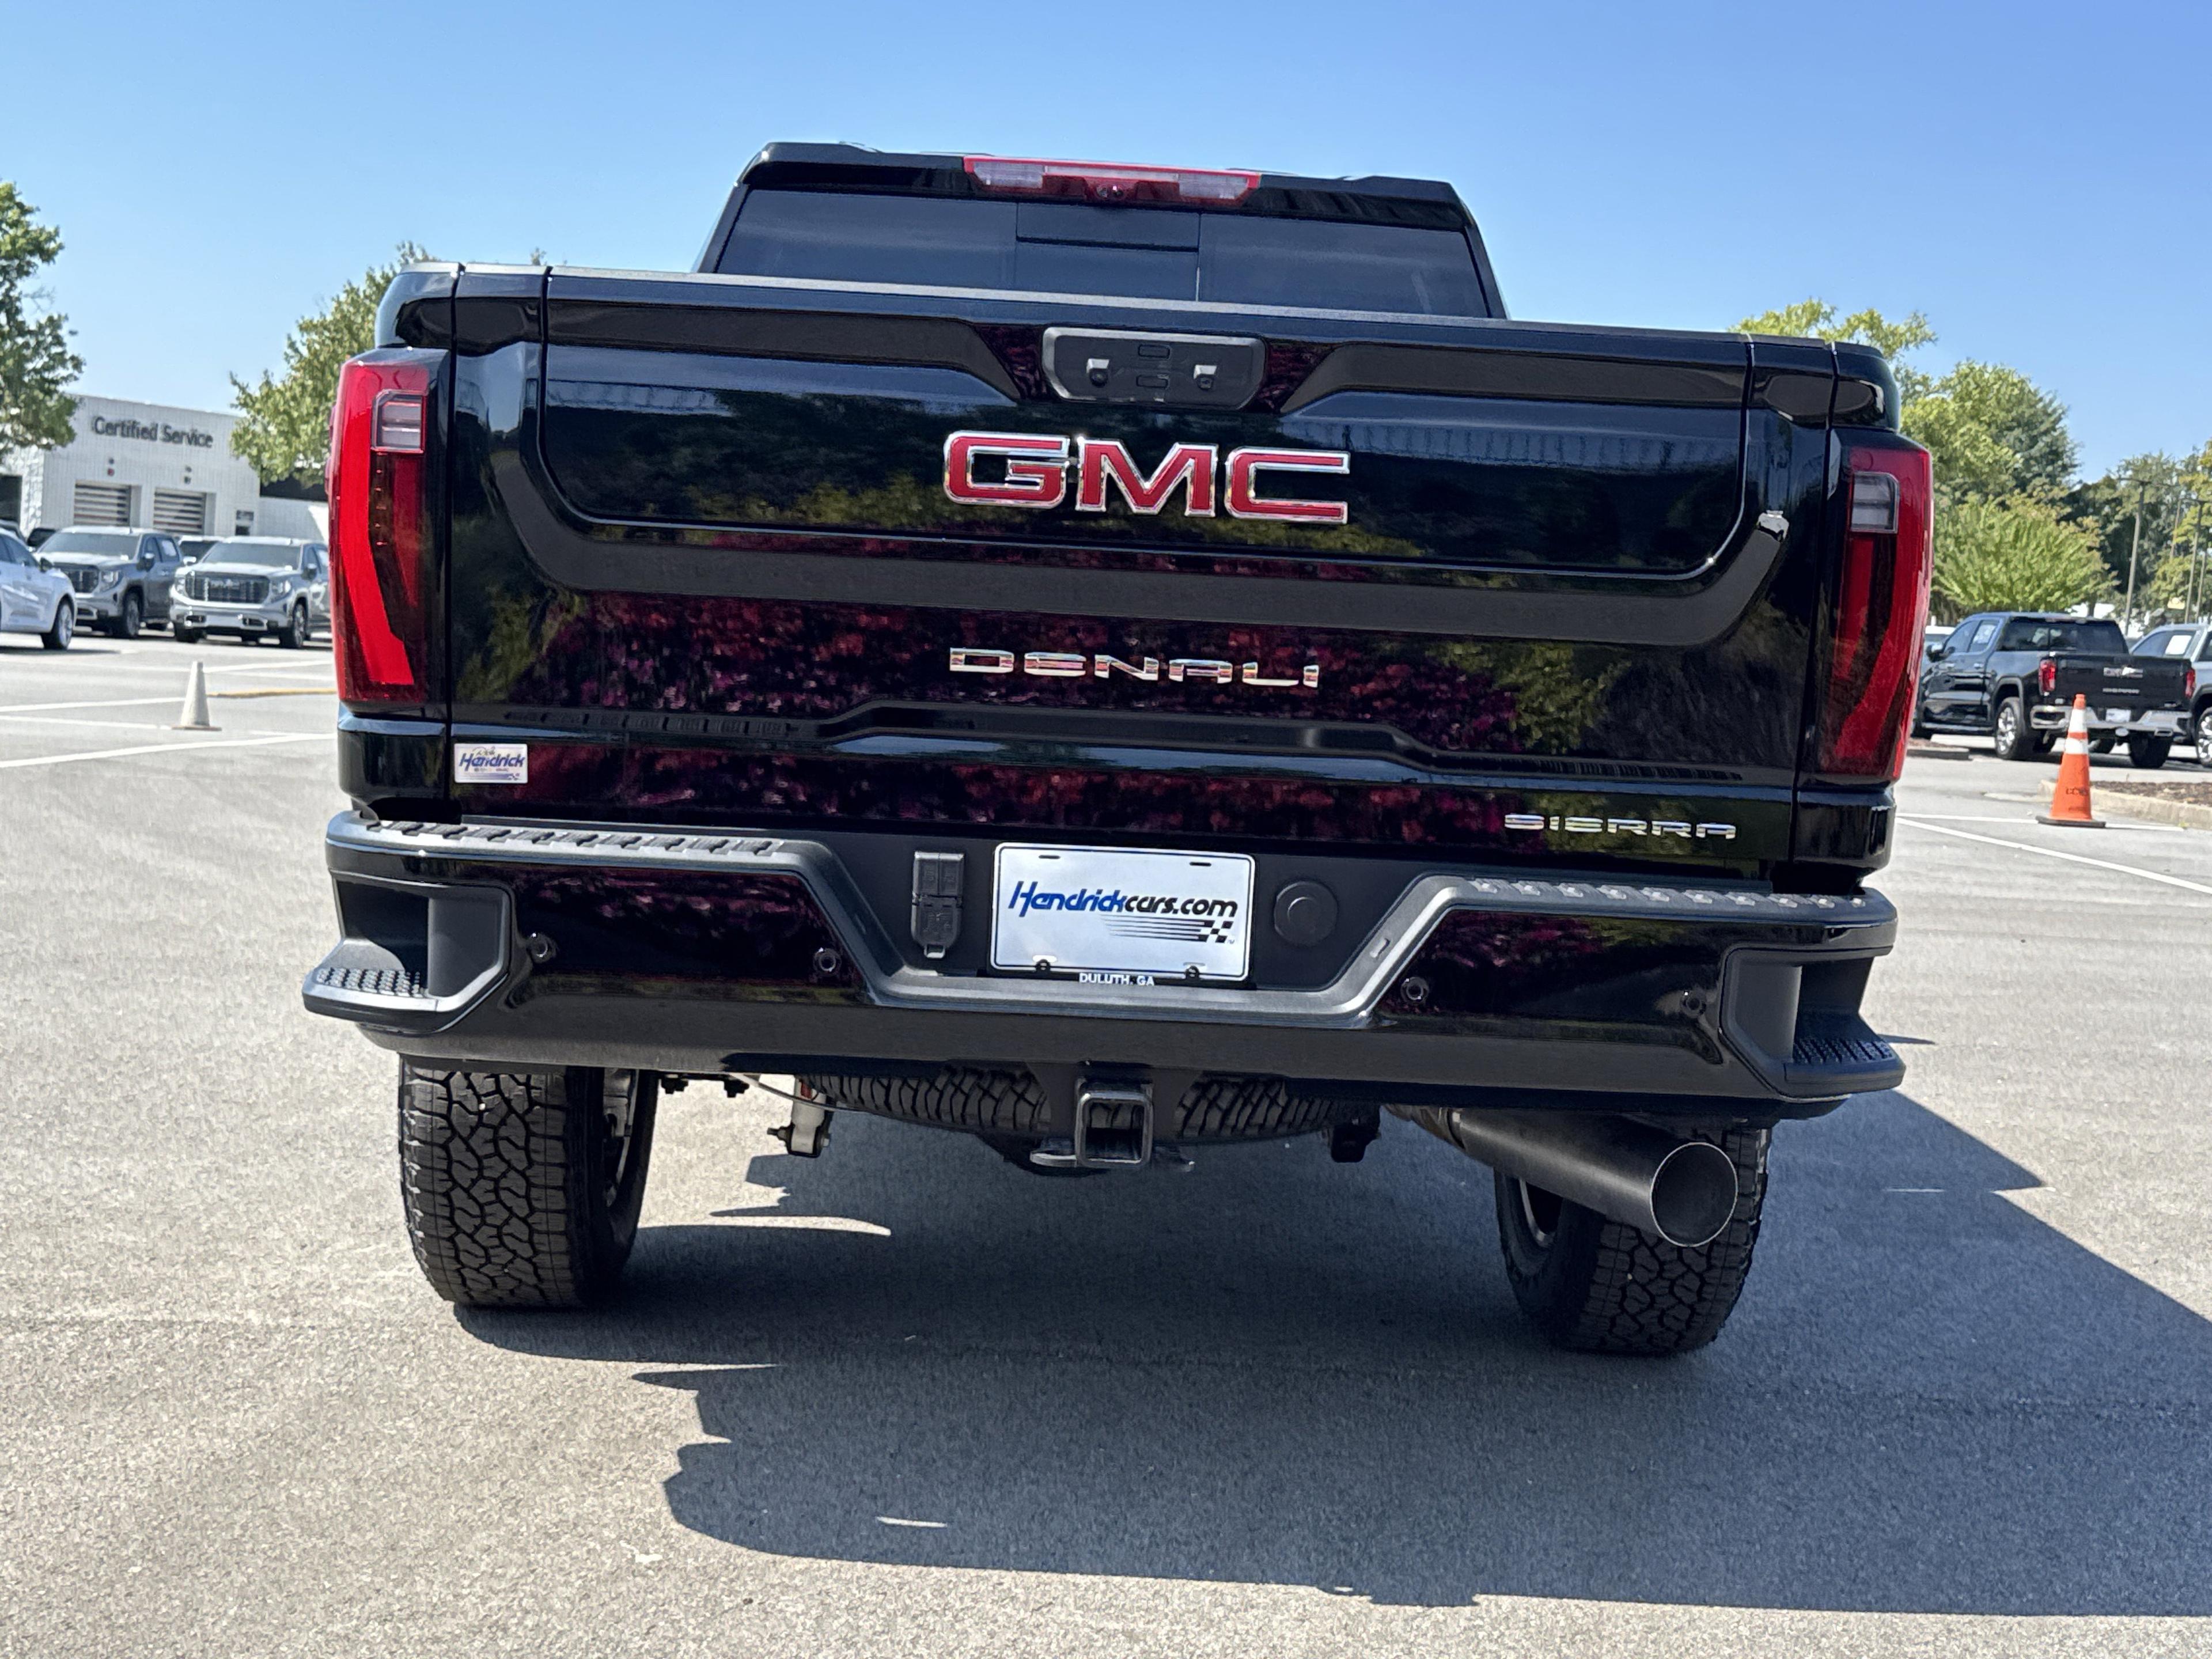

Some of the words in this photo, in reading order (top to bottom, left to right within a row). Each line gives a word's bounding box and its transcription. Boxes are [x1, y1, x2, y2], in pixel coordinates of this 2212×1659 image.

[92, 416, 159, 442] Certified
[160, 423, 213, 448] Service
[943, 430, 1351, 525] GMC
[949, 647, 1320, 689] DENALI
[459, 753, 525, 771] Hendrick
[1504, 814, 1737, 839] SIERRA
[1007, 881, 1238, 917] Hendrickcars.com
[1137, 975, 1154, 986] GA
